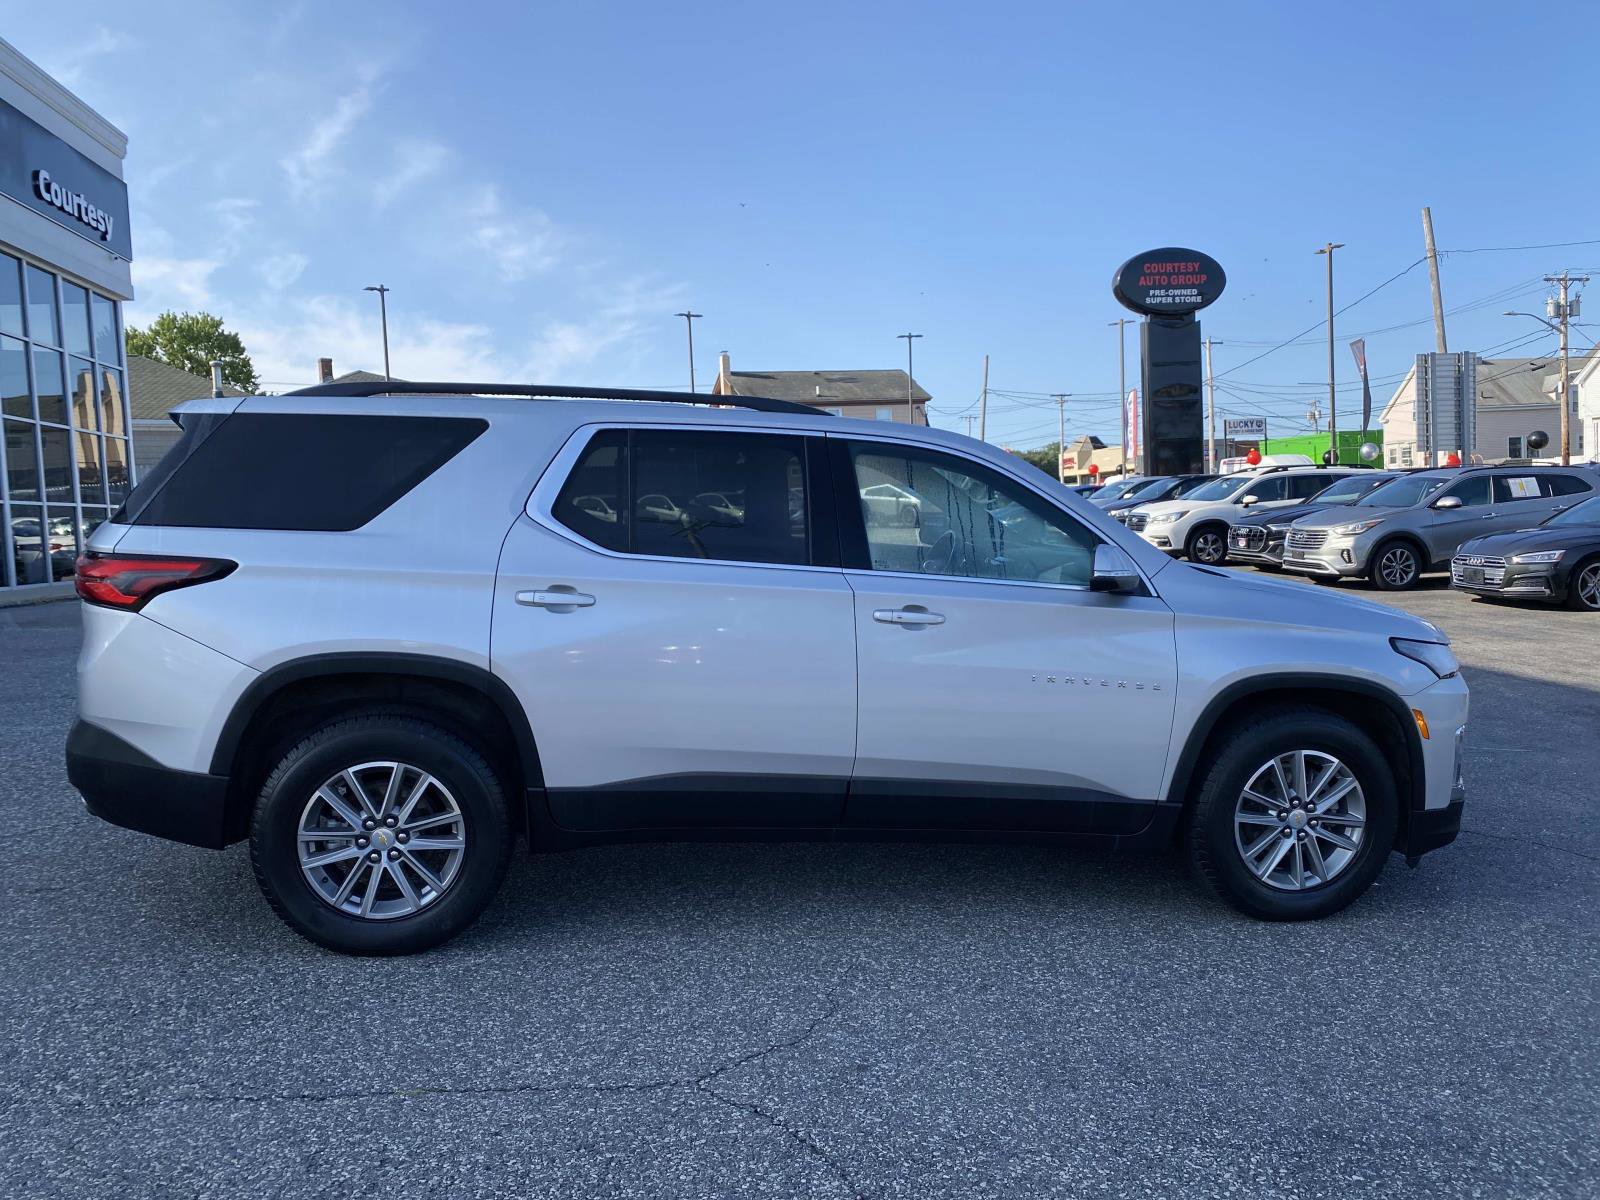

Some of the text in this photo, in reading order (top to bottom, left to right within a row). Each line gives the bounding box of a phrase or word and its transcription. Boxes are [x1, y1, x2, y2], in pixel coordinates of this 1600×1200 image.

[38, 169, 113, 241] Courtesy
[1143, 262, 1201, 273] COURTESY
[1139, 274, 1207, 286] AUTO GROUP
[1149, 288, 1198, 297] PRE-OWNED
[1229, 420, 1254, 428] LUCKY
